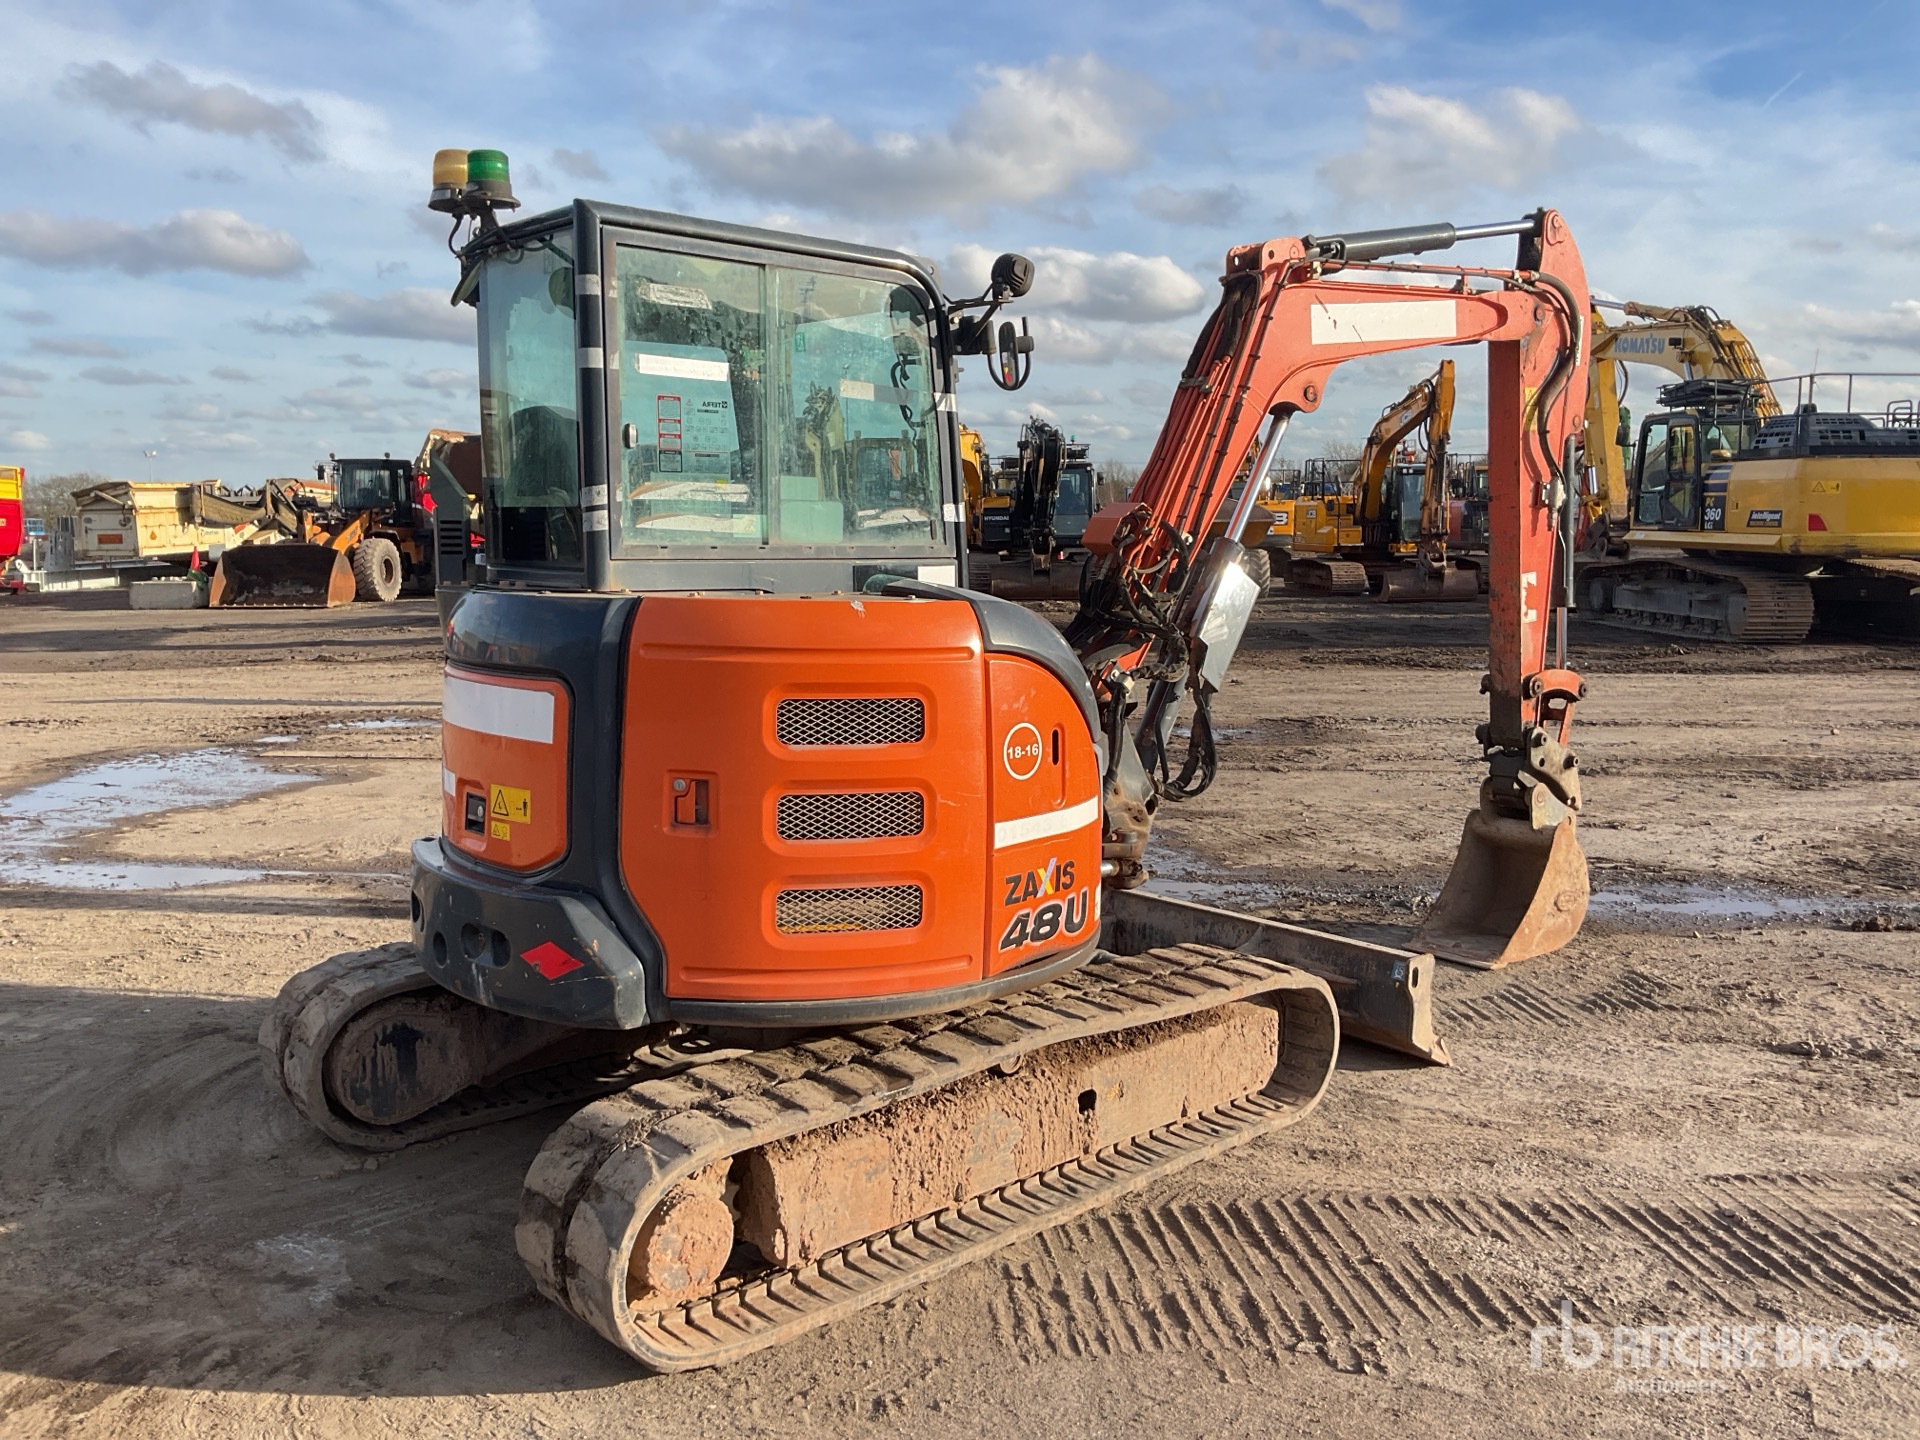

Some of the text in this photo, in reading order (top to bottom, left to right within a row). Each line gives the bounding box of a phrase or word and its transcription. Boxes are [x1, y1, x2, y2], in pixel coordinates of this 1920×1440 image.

[1614, 335, 1665, 354] KOMATSU
[1705, 497, 1714, 506] PC
[1704, 508, 1722, 520] 360
[1007, 743, 1039, 759] 18-16
[1005, 857, 1075, 907] ZAXIS
[999, 887, 1089, 951] 48U
